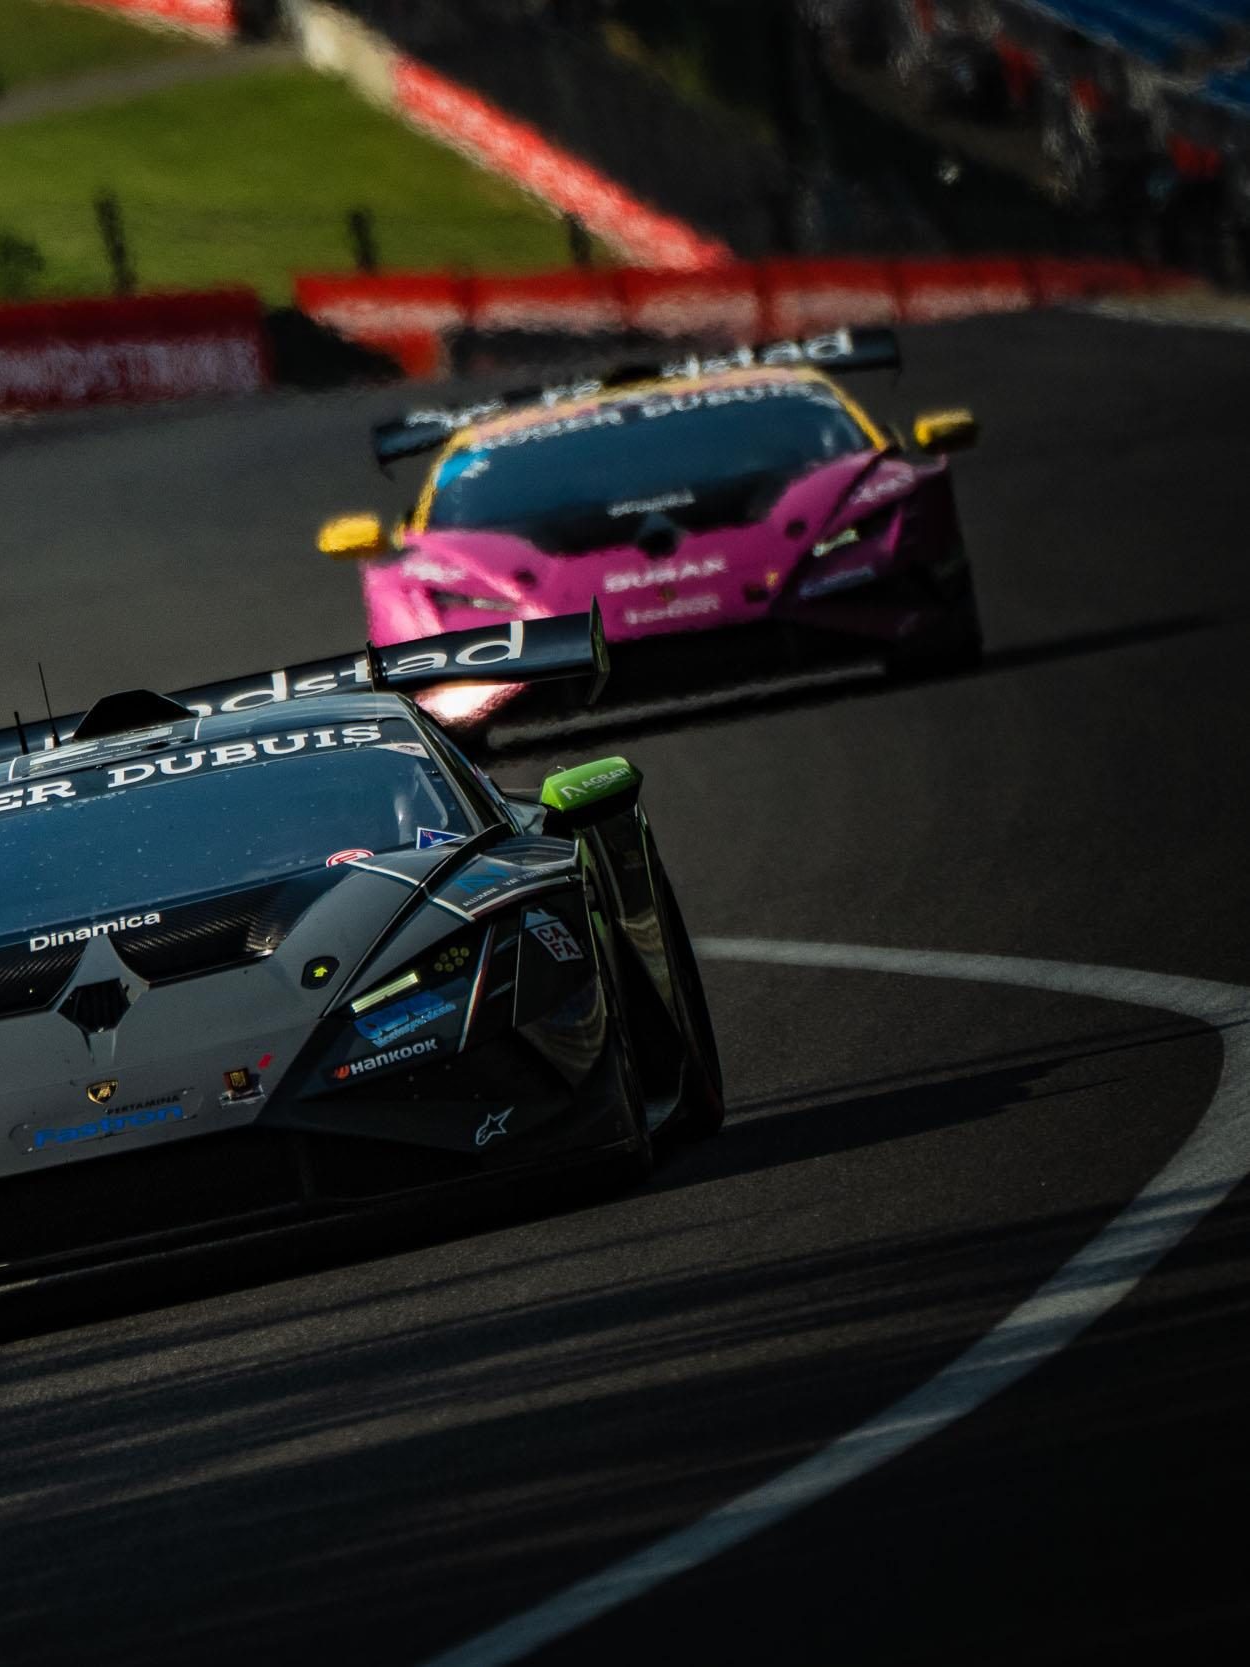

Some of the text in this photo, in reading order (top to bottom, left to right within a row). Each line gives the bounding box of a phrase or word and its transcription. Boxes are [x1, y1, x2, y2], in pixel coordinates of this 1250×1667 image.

[108, 723, 382, 789] DUBUIS
[582, 767, 630, 788] AGRATI
[30, 911, 161, 952] Dinamica
[35, 1104, 183, 1147] Fastron
